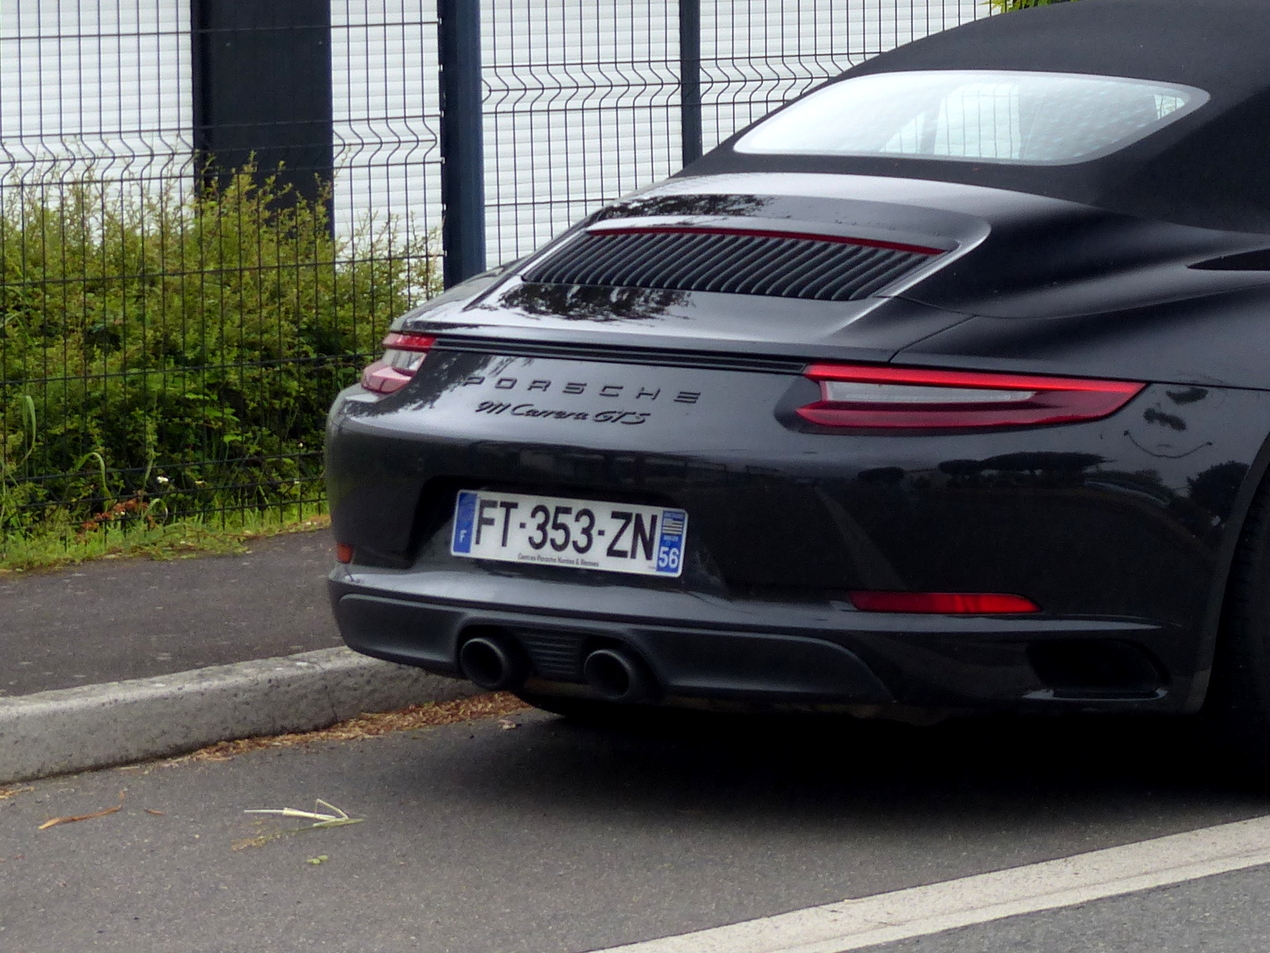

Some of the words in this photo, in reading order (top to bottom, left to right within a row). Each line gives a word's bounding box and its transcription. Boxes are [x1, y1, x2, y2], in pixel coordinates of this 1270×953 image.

[463, 376, 701, 404] PORSCHE
[475, 400, 511, 415] 911
[511, 403, 589, 421] Carrera
[592, 409, 652, 426] GTS
[459, 529, 468, 543] F
[475, 498, 658, 561] FT-353-ZN
[658, 546, 680, 569] 56
